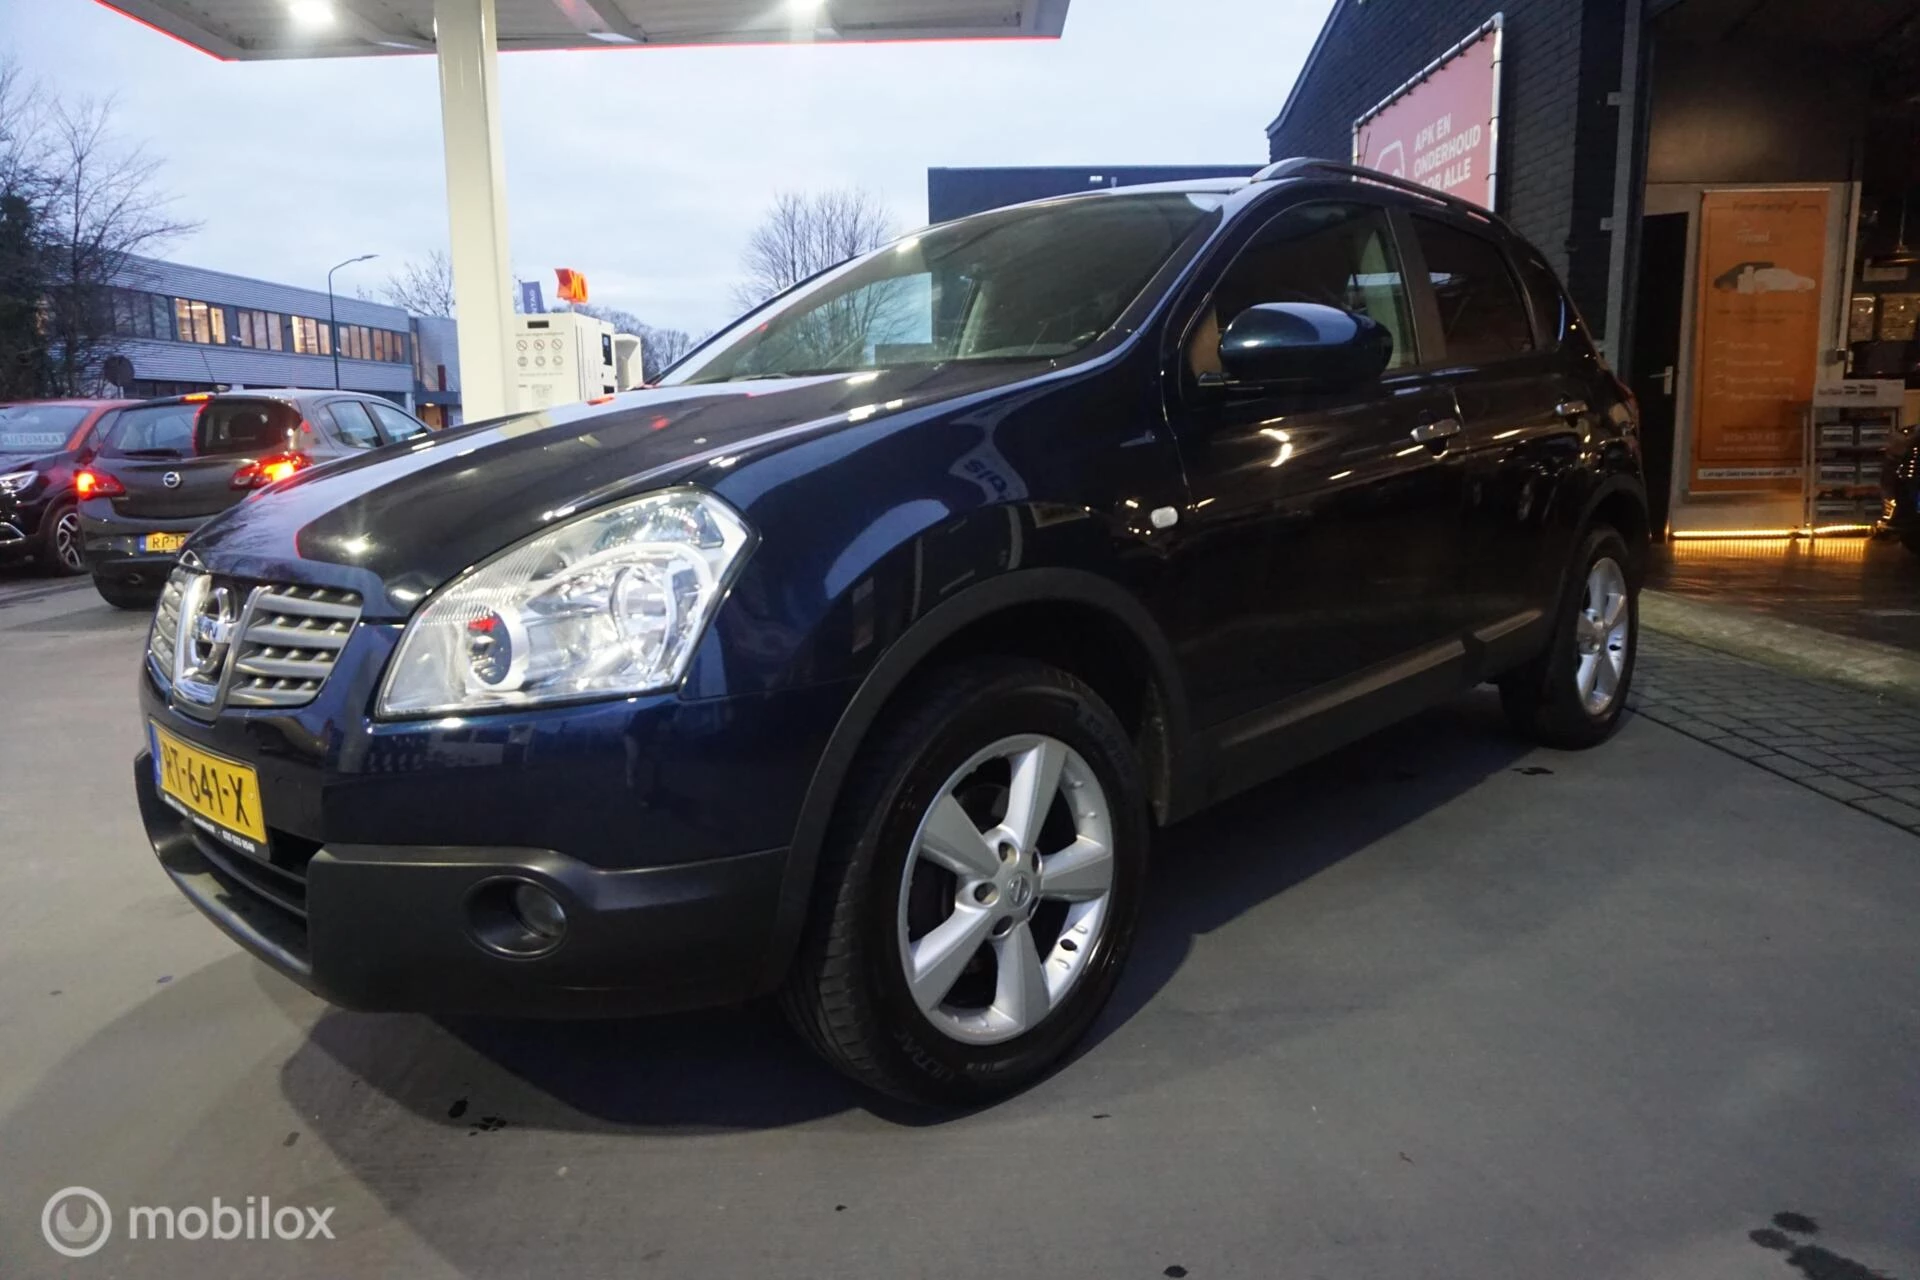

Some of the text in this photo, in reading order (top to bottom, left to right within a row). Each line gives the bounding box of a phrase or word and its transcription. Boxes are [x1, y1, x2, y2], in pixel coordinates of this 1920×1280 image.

[1414, 125, 1481, 178] ONDERHOUD
[1415, 112, 1451, 153] APK EN
[1443, 157, 1472, 190] ALLE
